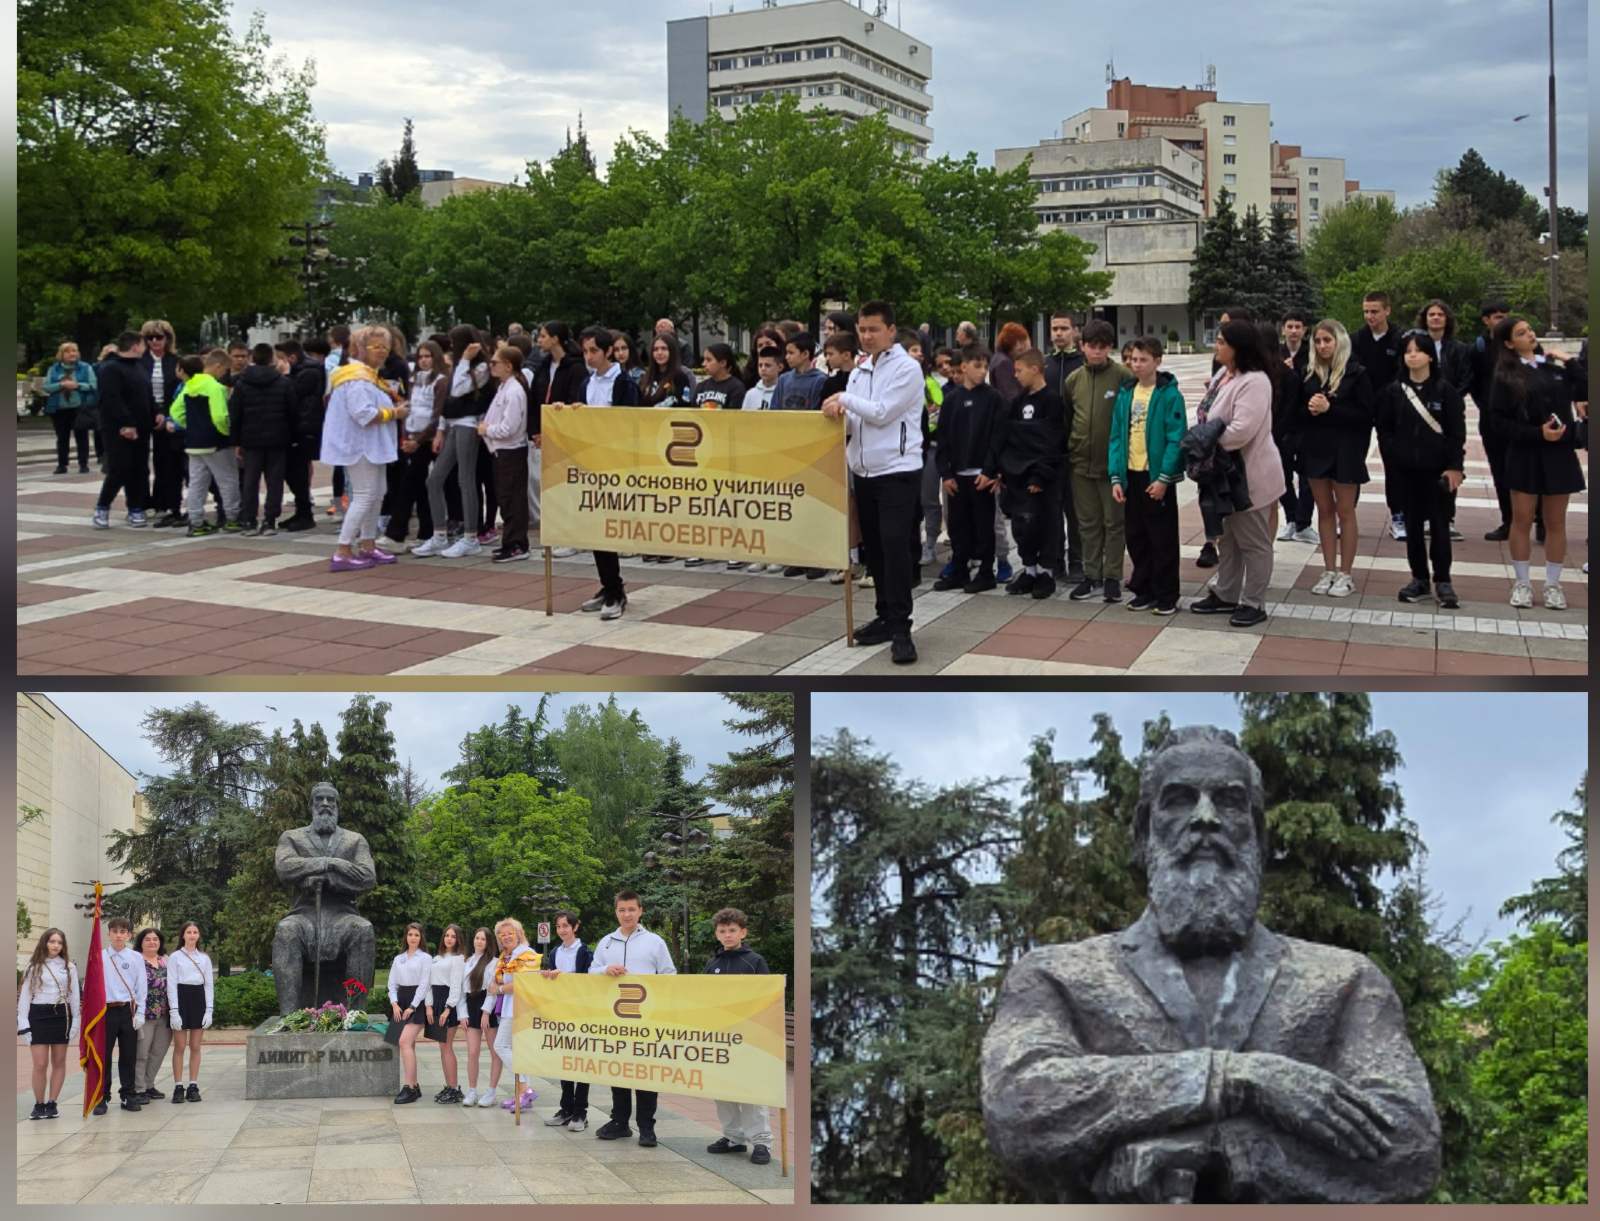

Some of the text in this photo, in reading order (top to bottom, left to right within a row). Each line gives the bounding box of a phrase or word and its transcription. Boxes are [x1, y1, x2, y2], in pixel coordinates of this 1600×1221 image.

[567, 467, 805, 498] Второ основно училище
[579, 490, 793, 521] ДИМИТЪР БЛАГОЕВ
[604, 518, 766, 554] БЛАГОЕВГРАД
[532, 1016, 743, 1046] Второ основно училище
[541, 1034, 730, 1064] ДИМИТЪР БЛАГОЕВ
[561, 1055, 703, 1089] БЛАГОЕВГРАД
